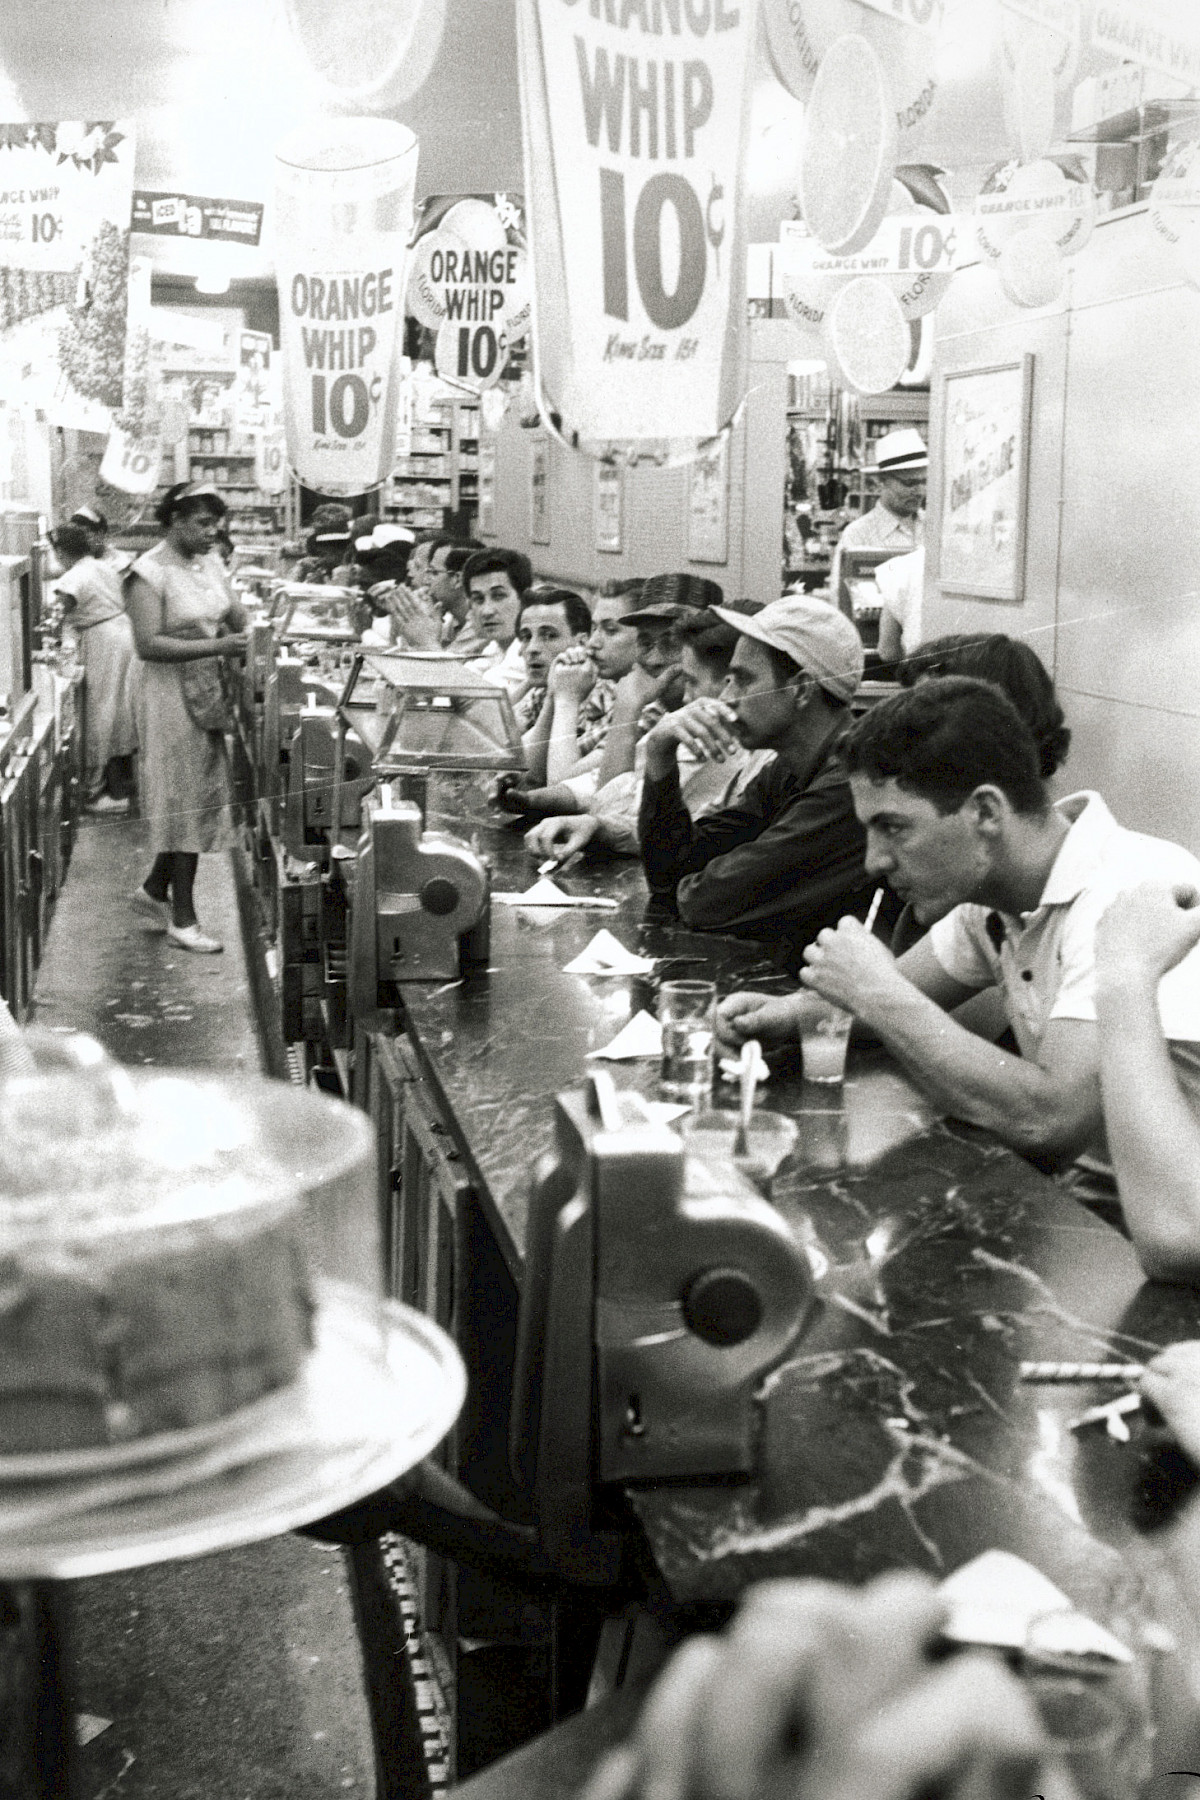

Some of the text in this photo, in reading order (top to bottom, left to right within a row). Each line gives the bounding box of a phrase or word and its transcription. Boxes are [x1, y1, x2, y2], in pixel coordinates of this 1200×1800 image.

[573, 33, 714, 160] WHIP
[0, 186, 60, 204] NGE WHIP
[980, 199, 1030, 215] ORANGE
[1034, 195, 1065, 209] WHIP
[32, 212, 63, 243] 10¢
[599, 167, 725, 331] 10¢
[899, 225, 957, 270] 10¢
[431, 249, 518, 284] ORANGE
[812, 258, 889, 271] ORANGE WHIP
[291, 268, 393, 321] ORANGE
[418, 273, 447, 317] FLORIDA
[445, 288, 504, 321] WHIP
[900, 272, 932, 306] FLOR
[302, 326, 376, 371] WHIP
[457, 326, 507, 377] 10¢
[312, 371, 382, 438] 10¢
